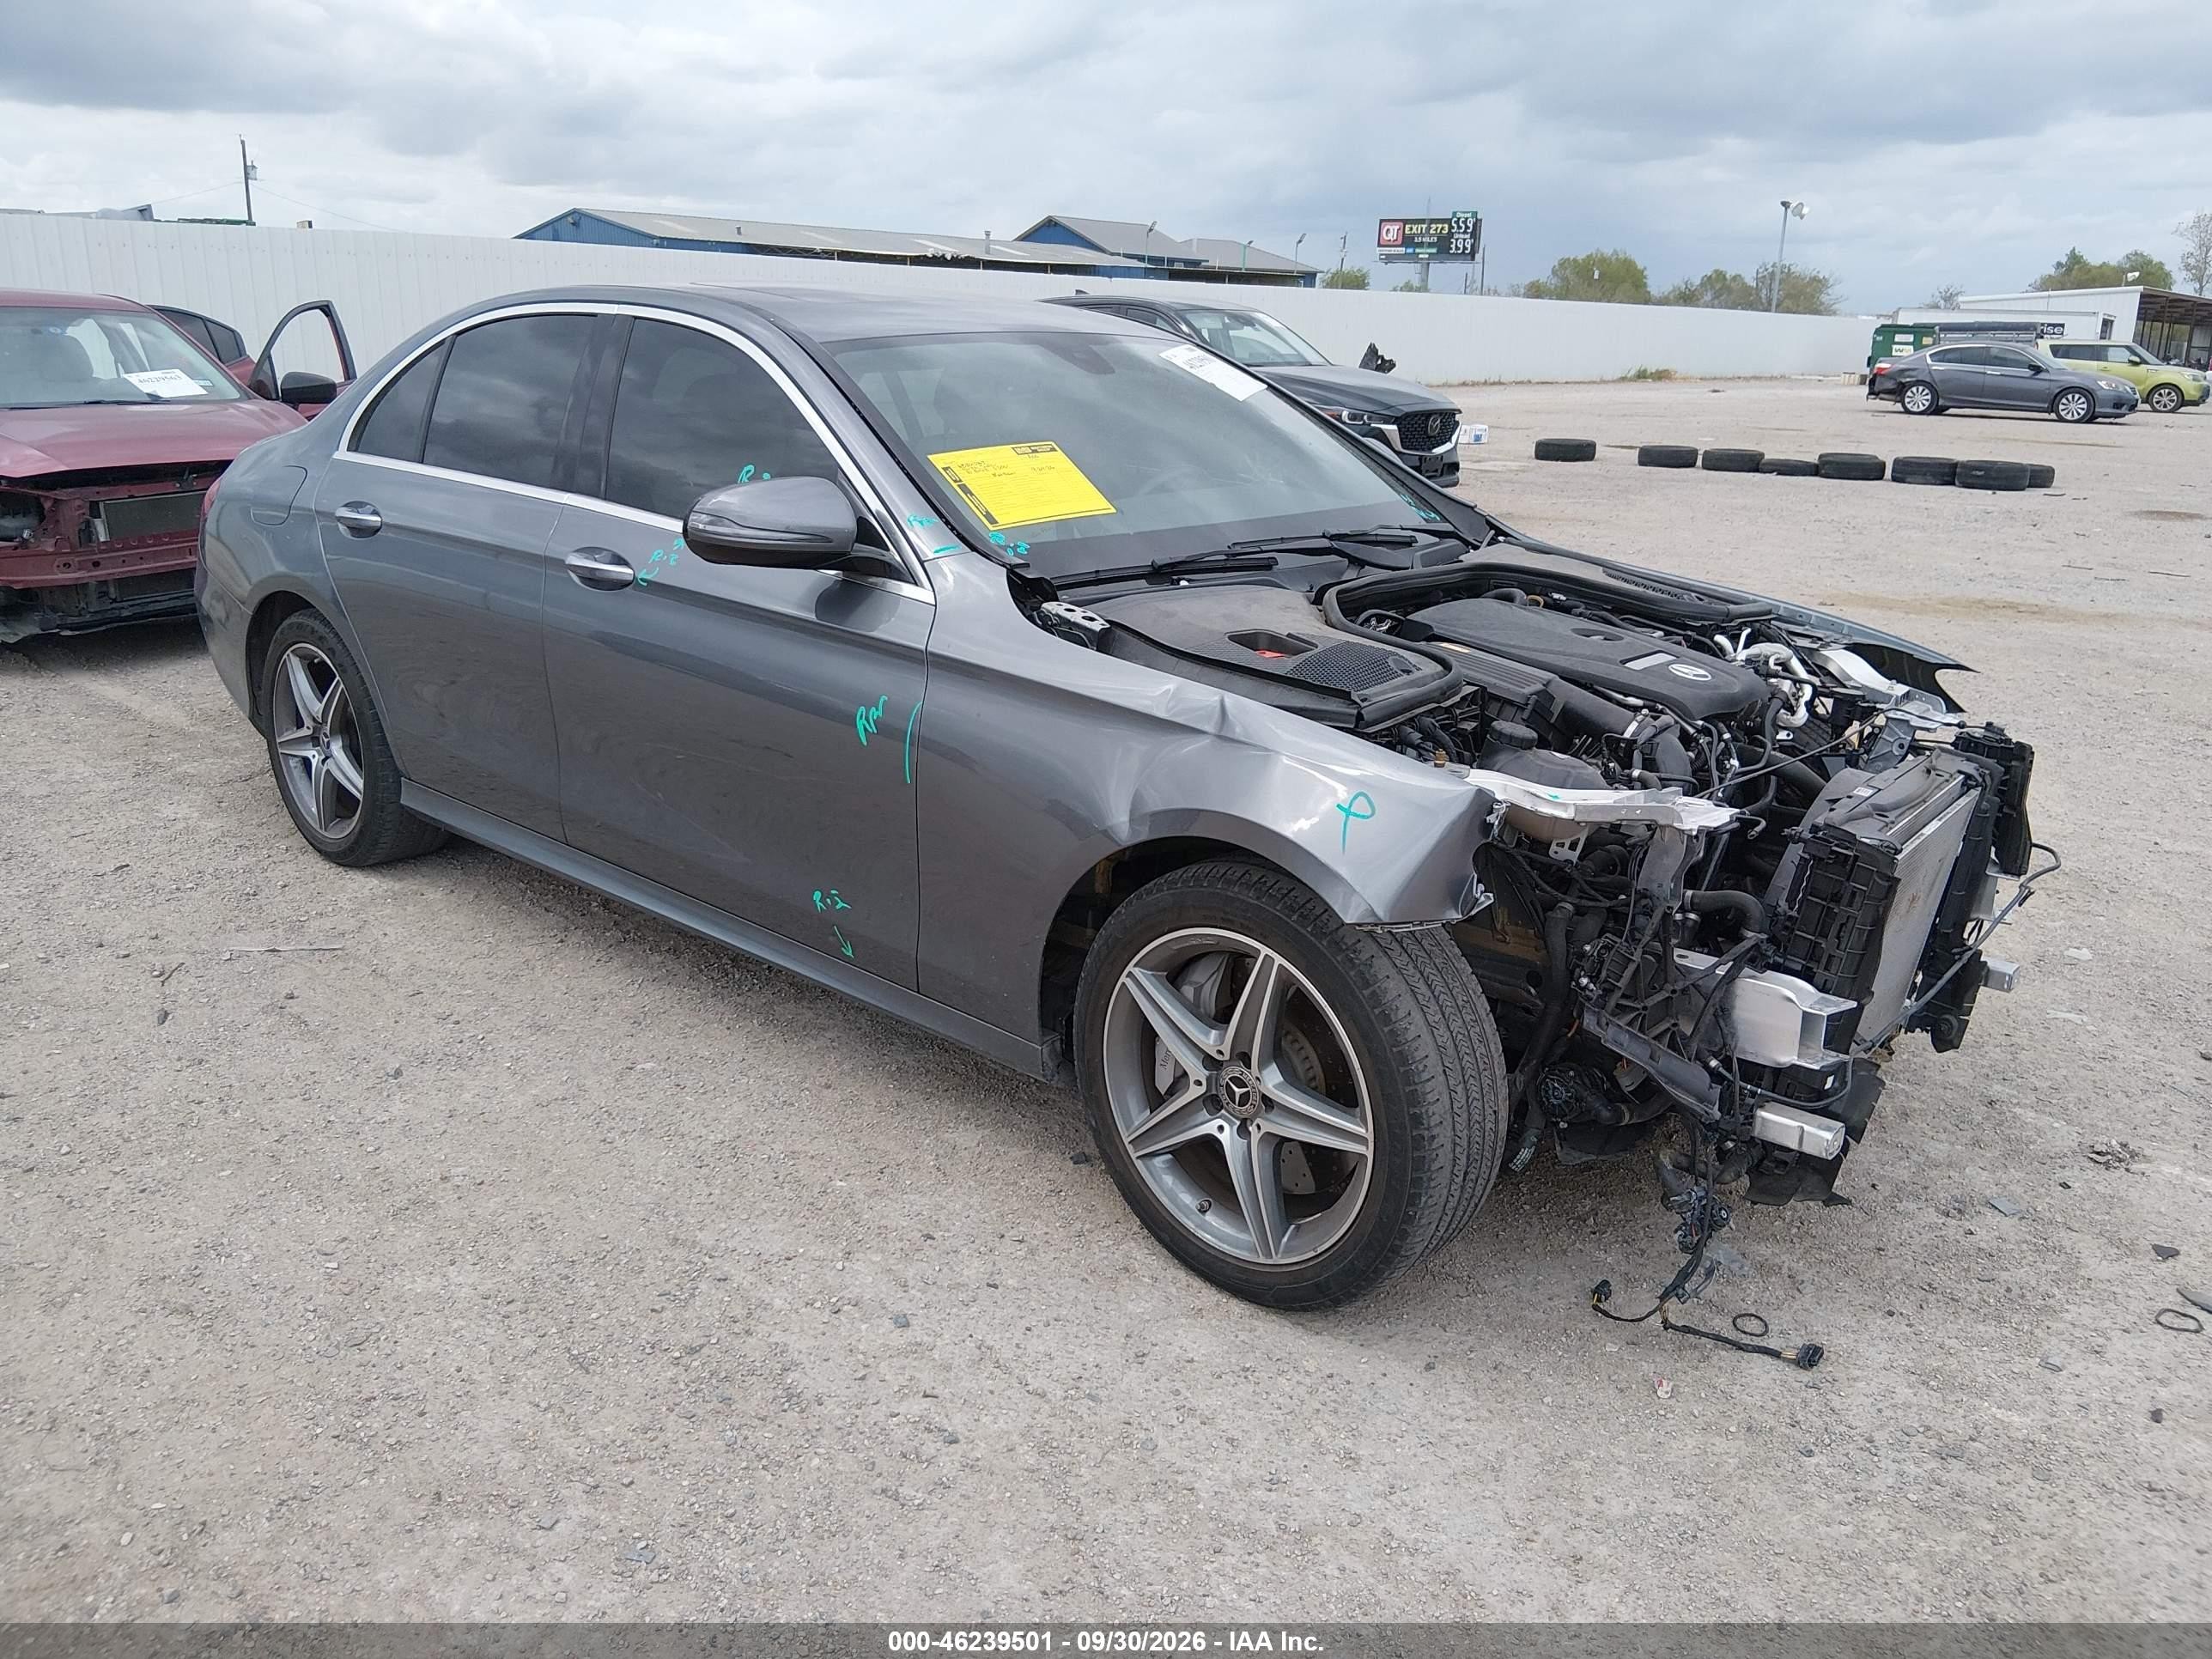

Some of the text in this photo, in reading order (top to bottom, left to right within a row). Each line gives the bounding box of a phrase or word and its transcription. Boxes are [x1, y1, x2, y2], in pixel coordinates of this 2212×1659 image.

[1382, 225, 1400, 241] QT
[1404, 223, 1449, 234] EXIT 273
